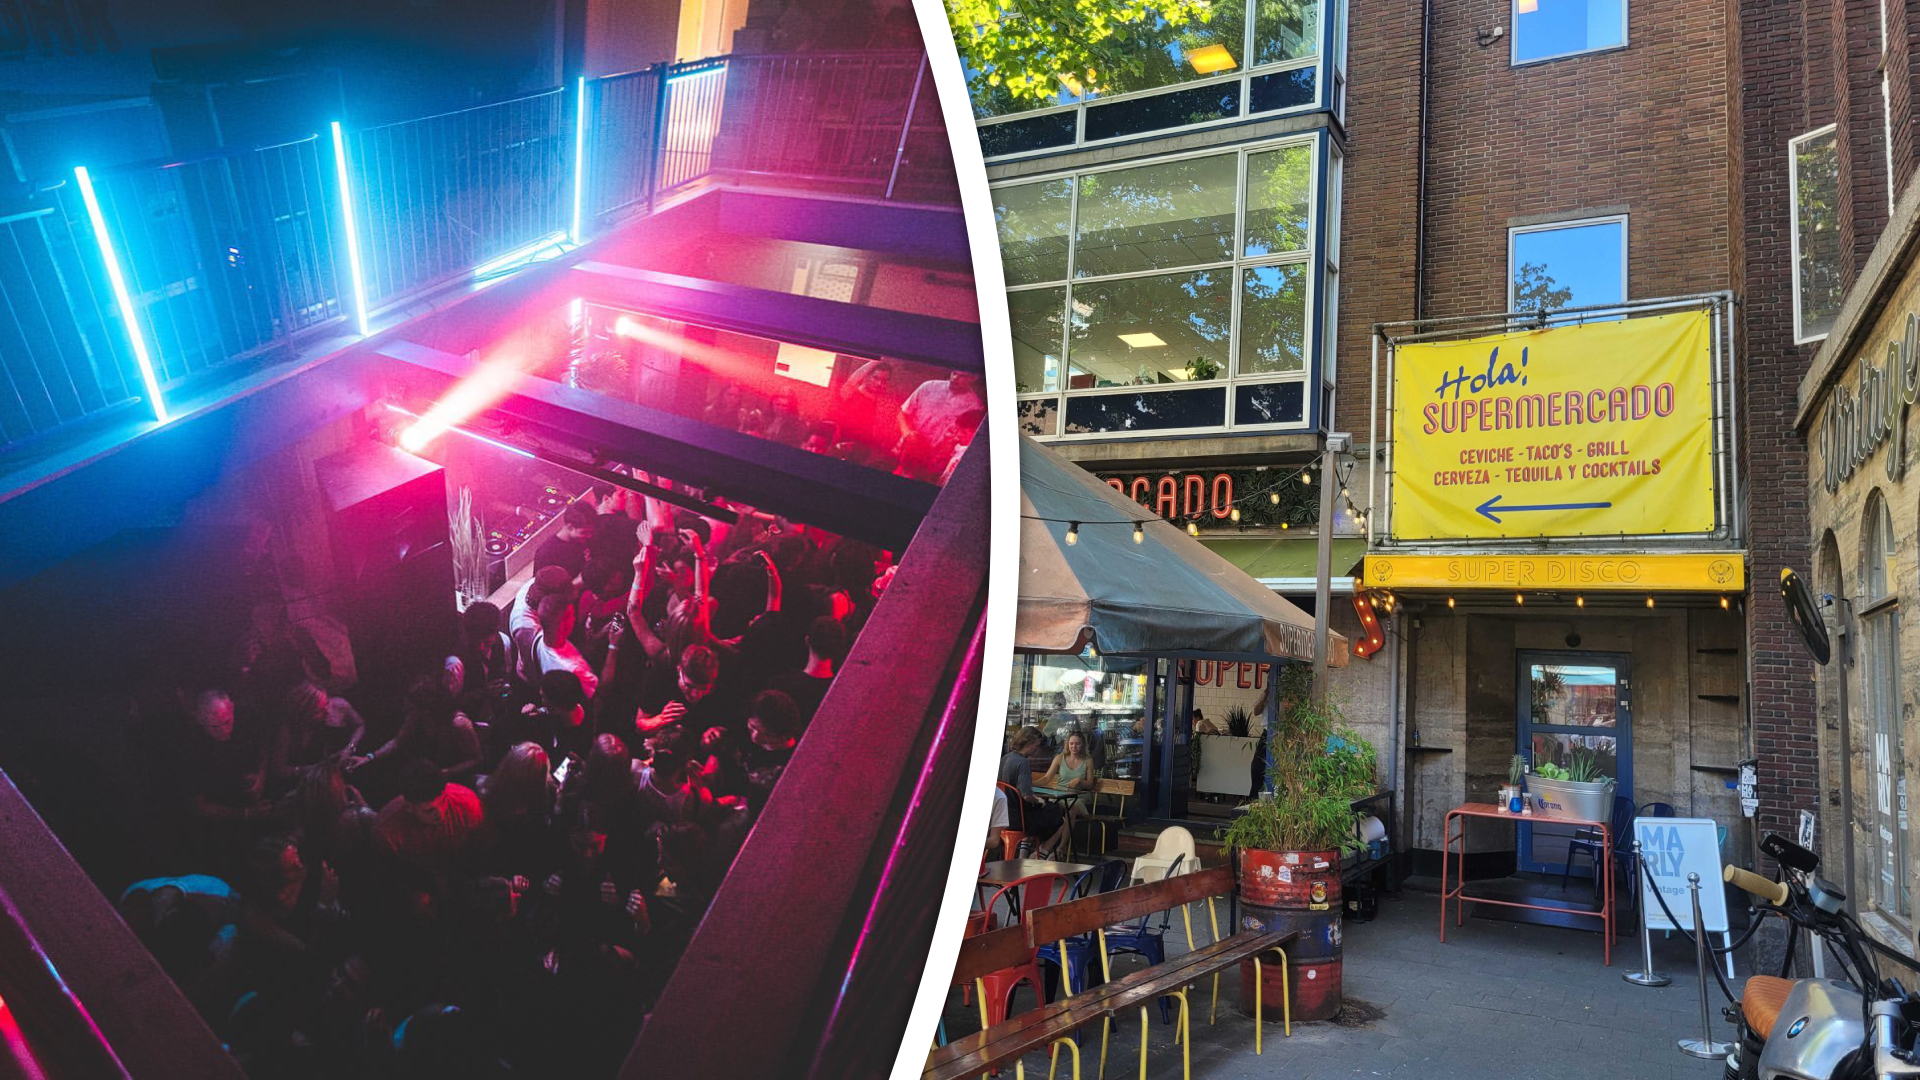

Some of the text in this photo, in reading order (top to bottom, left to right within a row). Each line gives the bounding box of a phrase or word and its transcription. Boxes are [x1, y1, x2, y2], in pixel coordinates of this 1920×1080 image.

[1434, 346, 1529, 400] Hola!
[1423, 382, 1675, 435] SUPERMERCADO
[1820, 312, 1920, 495] Vintage
[1459, 446, 1514, 465] CEVICHE
[1587, 440, 1630, 457] GRILL
[1433, 469, 1490, 486] CERVEZA
[1505, 465, 1563, 483] TEQUILA
[1568, 464, 1577, 480] Y
[1582, 459, 1661, 479] COCKTAILS
[1448, 560, 1641, 583] SUPER DISCO
[1538, 798, 1562, 811] Corona
[1641, 825, 1684, 852] MA
[1643, 851, 1685, 877] RLY
[1646, 884, 1685, 896] Vntage
